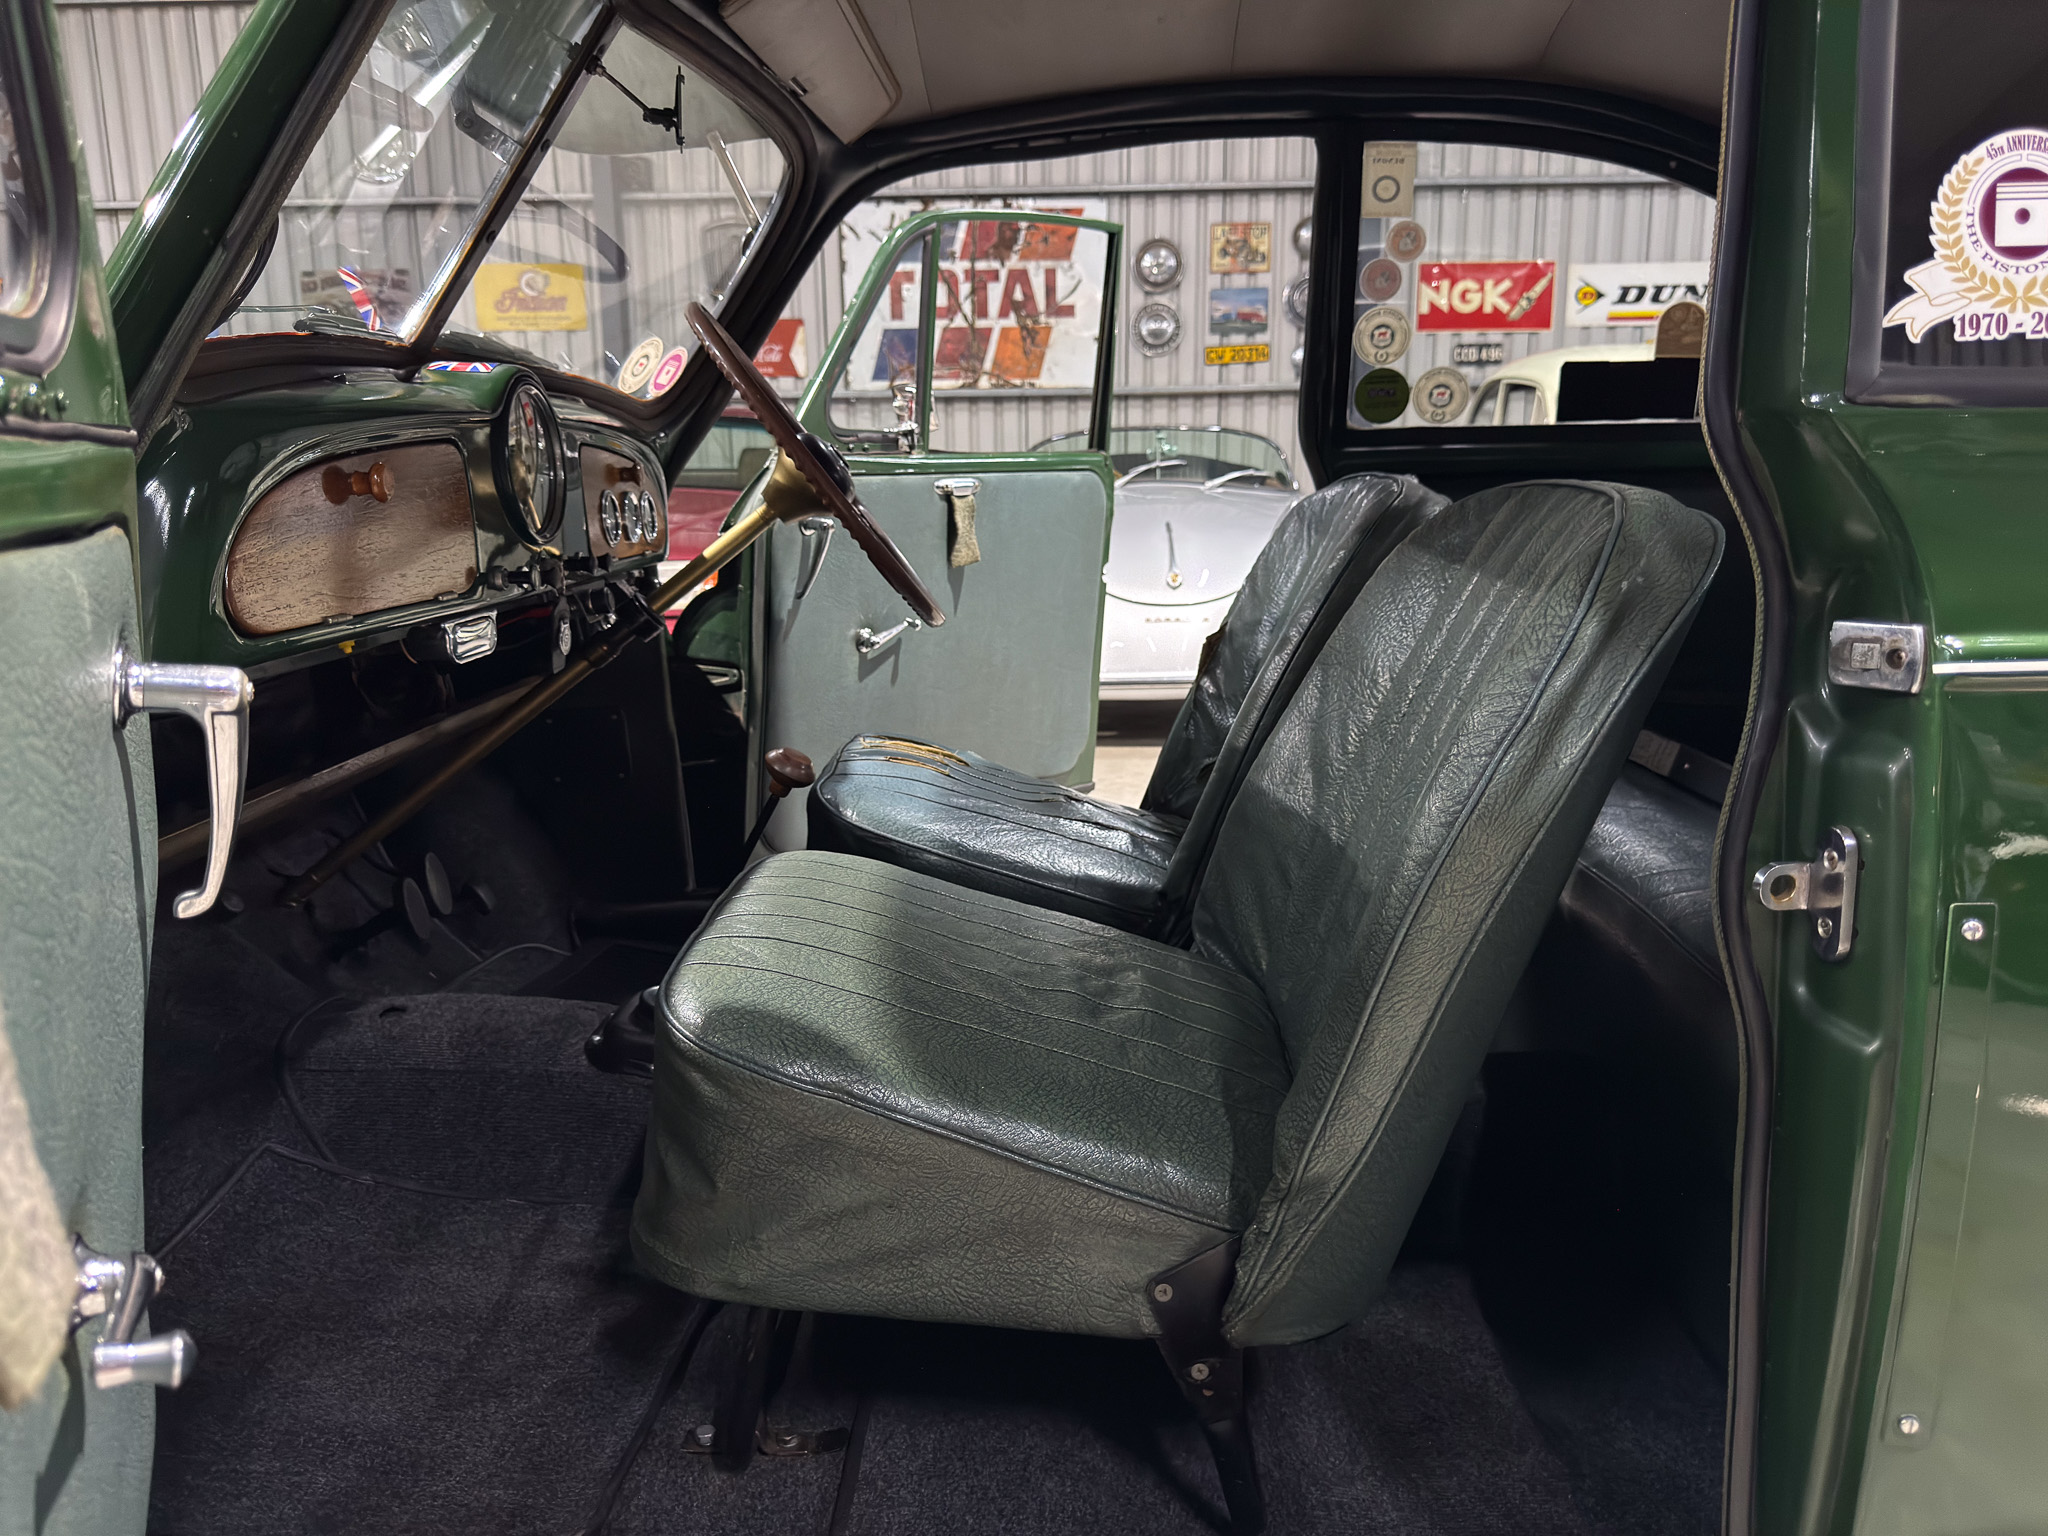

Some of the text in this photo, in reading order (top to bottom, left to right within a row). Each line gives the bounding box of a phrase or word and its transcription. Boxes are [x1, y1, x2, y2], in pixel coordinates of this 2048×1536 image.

[1966, 206, 1983, 252] THE
[888, 268, 1076, 321] TOTAL
[1418, 277, 1515, 315] NGK
[1957, 313, 2009, 338] 1970
